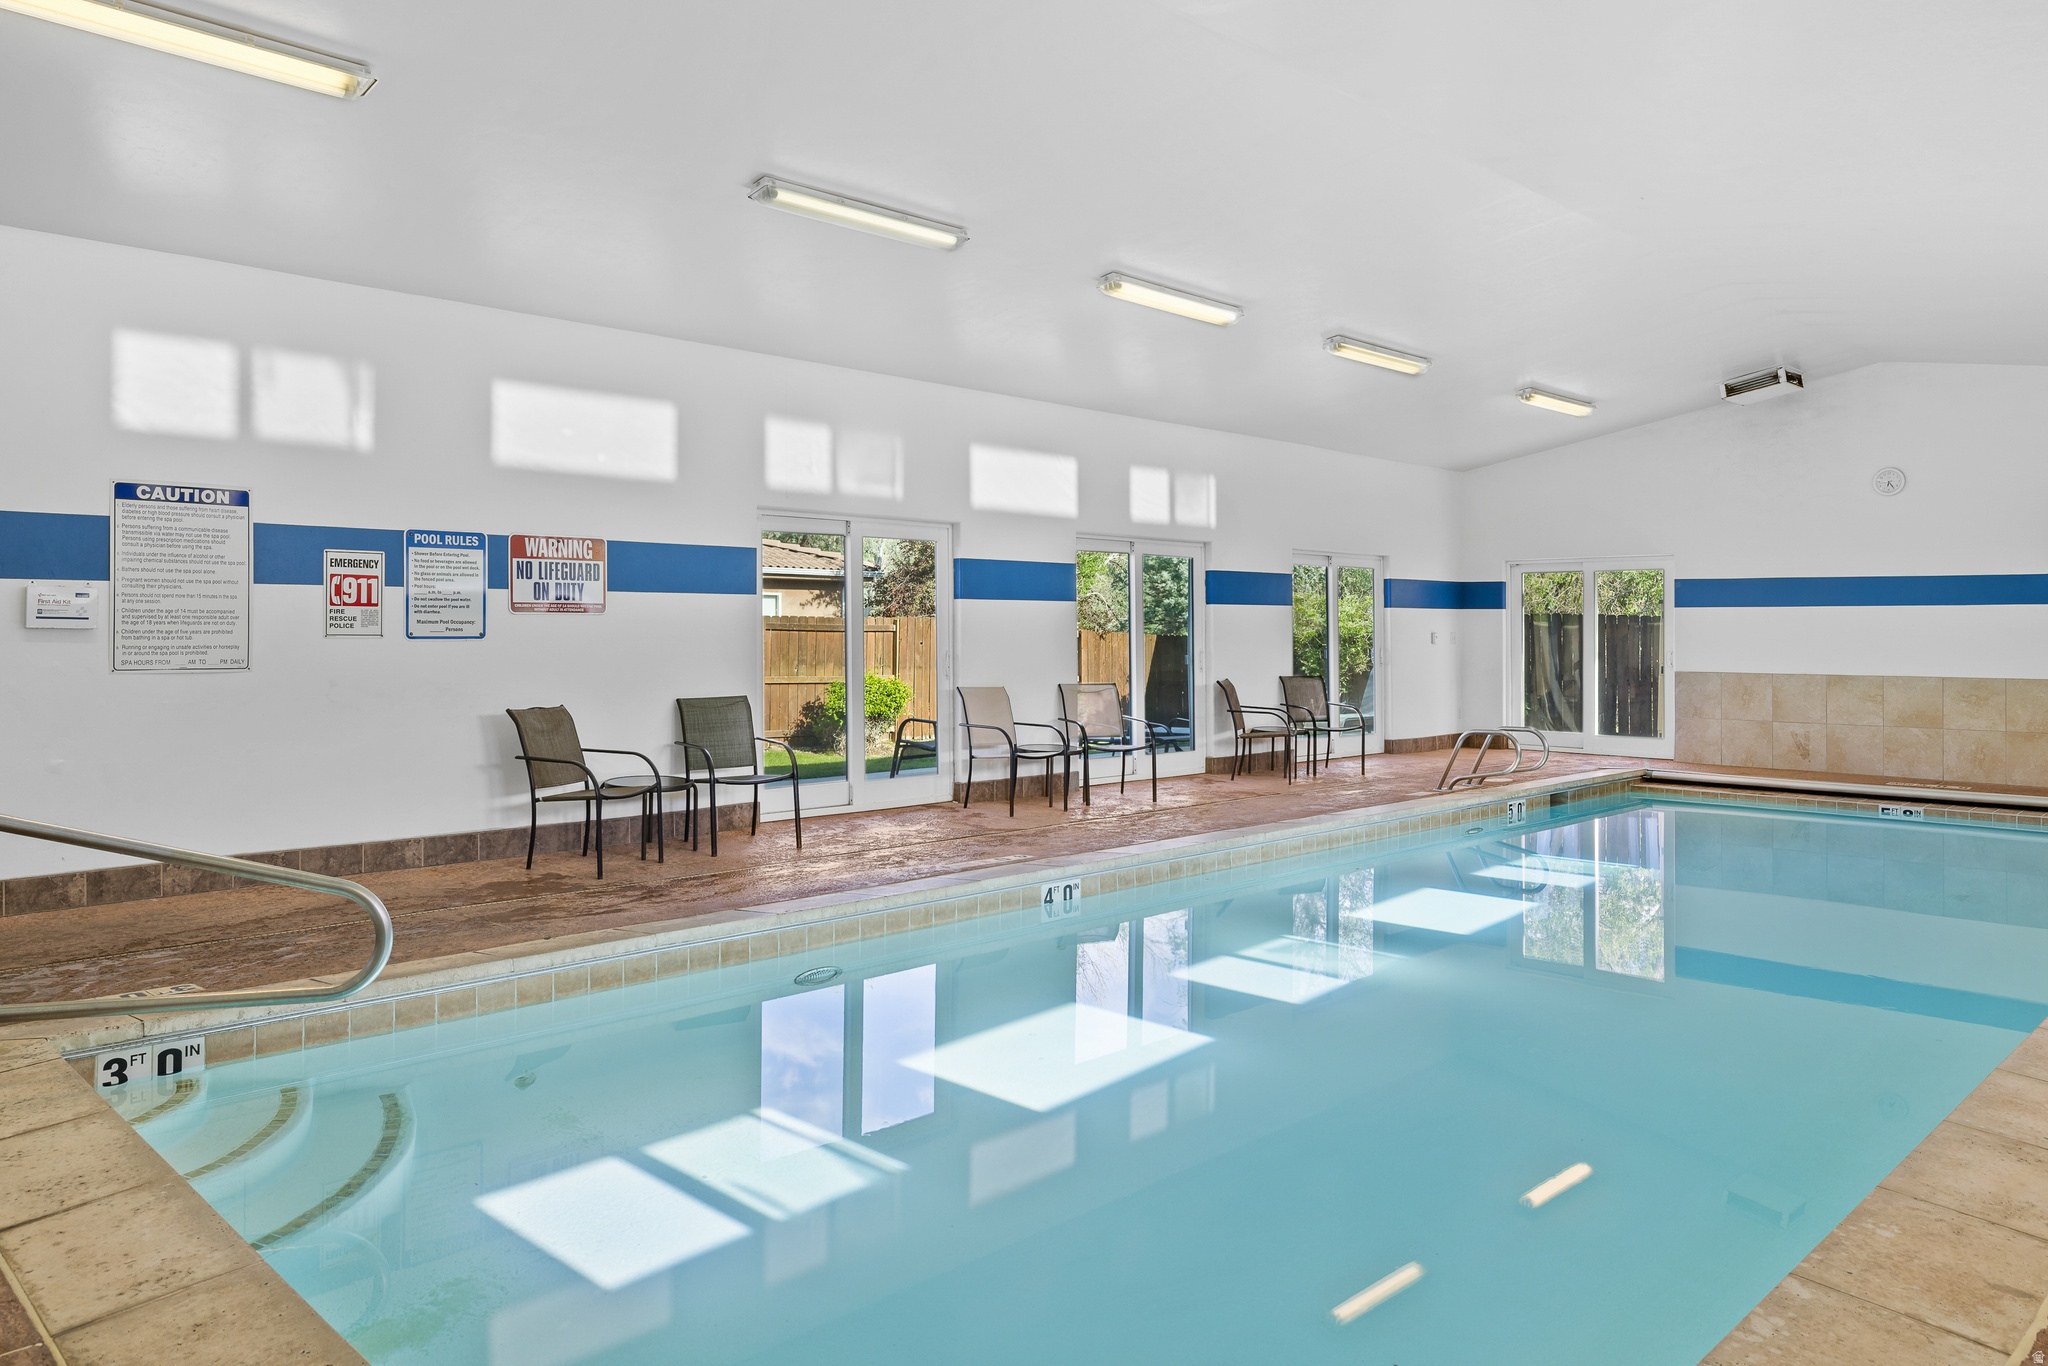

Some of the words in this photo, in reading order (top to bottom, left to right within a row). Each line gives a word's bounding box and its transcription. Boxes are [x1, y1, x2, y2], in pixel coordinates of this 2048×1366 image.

[136, 485, 230, 504] CAUTION
[414, 533, 443, 545] POOL
[445, 534, 479, 546] RULES
[524, 537, 593, 560] WARNING
[330, 558, 379, 569] EMERGENCY
[516, 560, 533, 580] NO
[538, 561, 600, 581] LIFEGUARD
[343, 577, 378, 604] 911
[533, 582, 550, 601] ON
[554, 582, 584, 601] DUTY
[1044, 887, 1053, 904] 4
[1054, 886, 1060, 894] FT
[1063, 884, 1073, 901] 0
[102, 1058, 128, 1087] 3
[130, 1052, 147, 1067] FT
[157, 1048, 183, 1077] 0
[185, 1044, 200, 1058] IN
